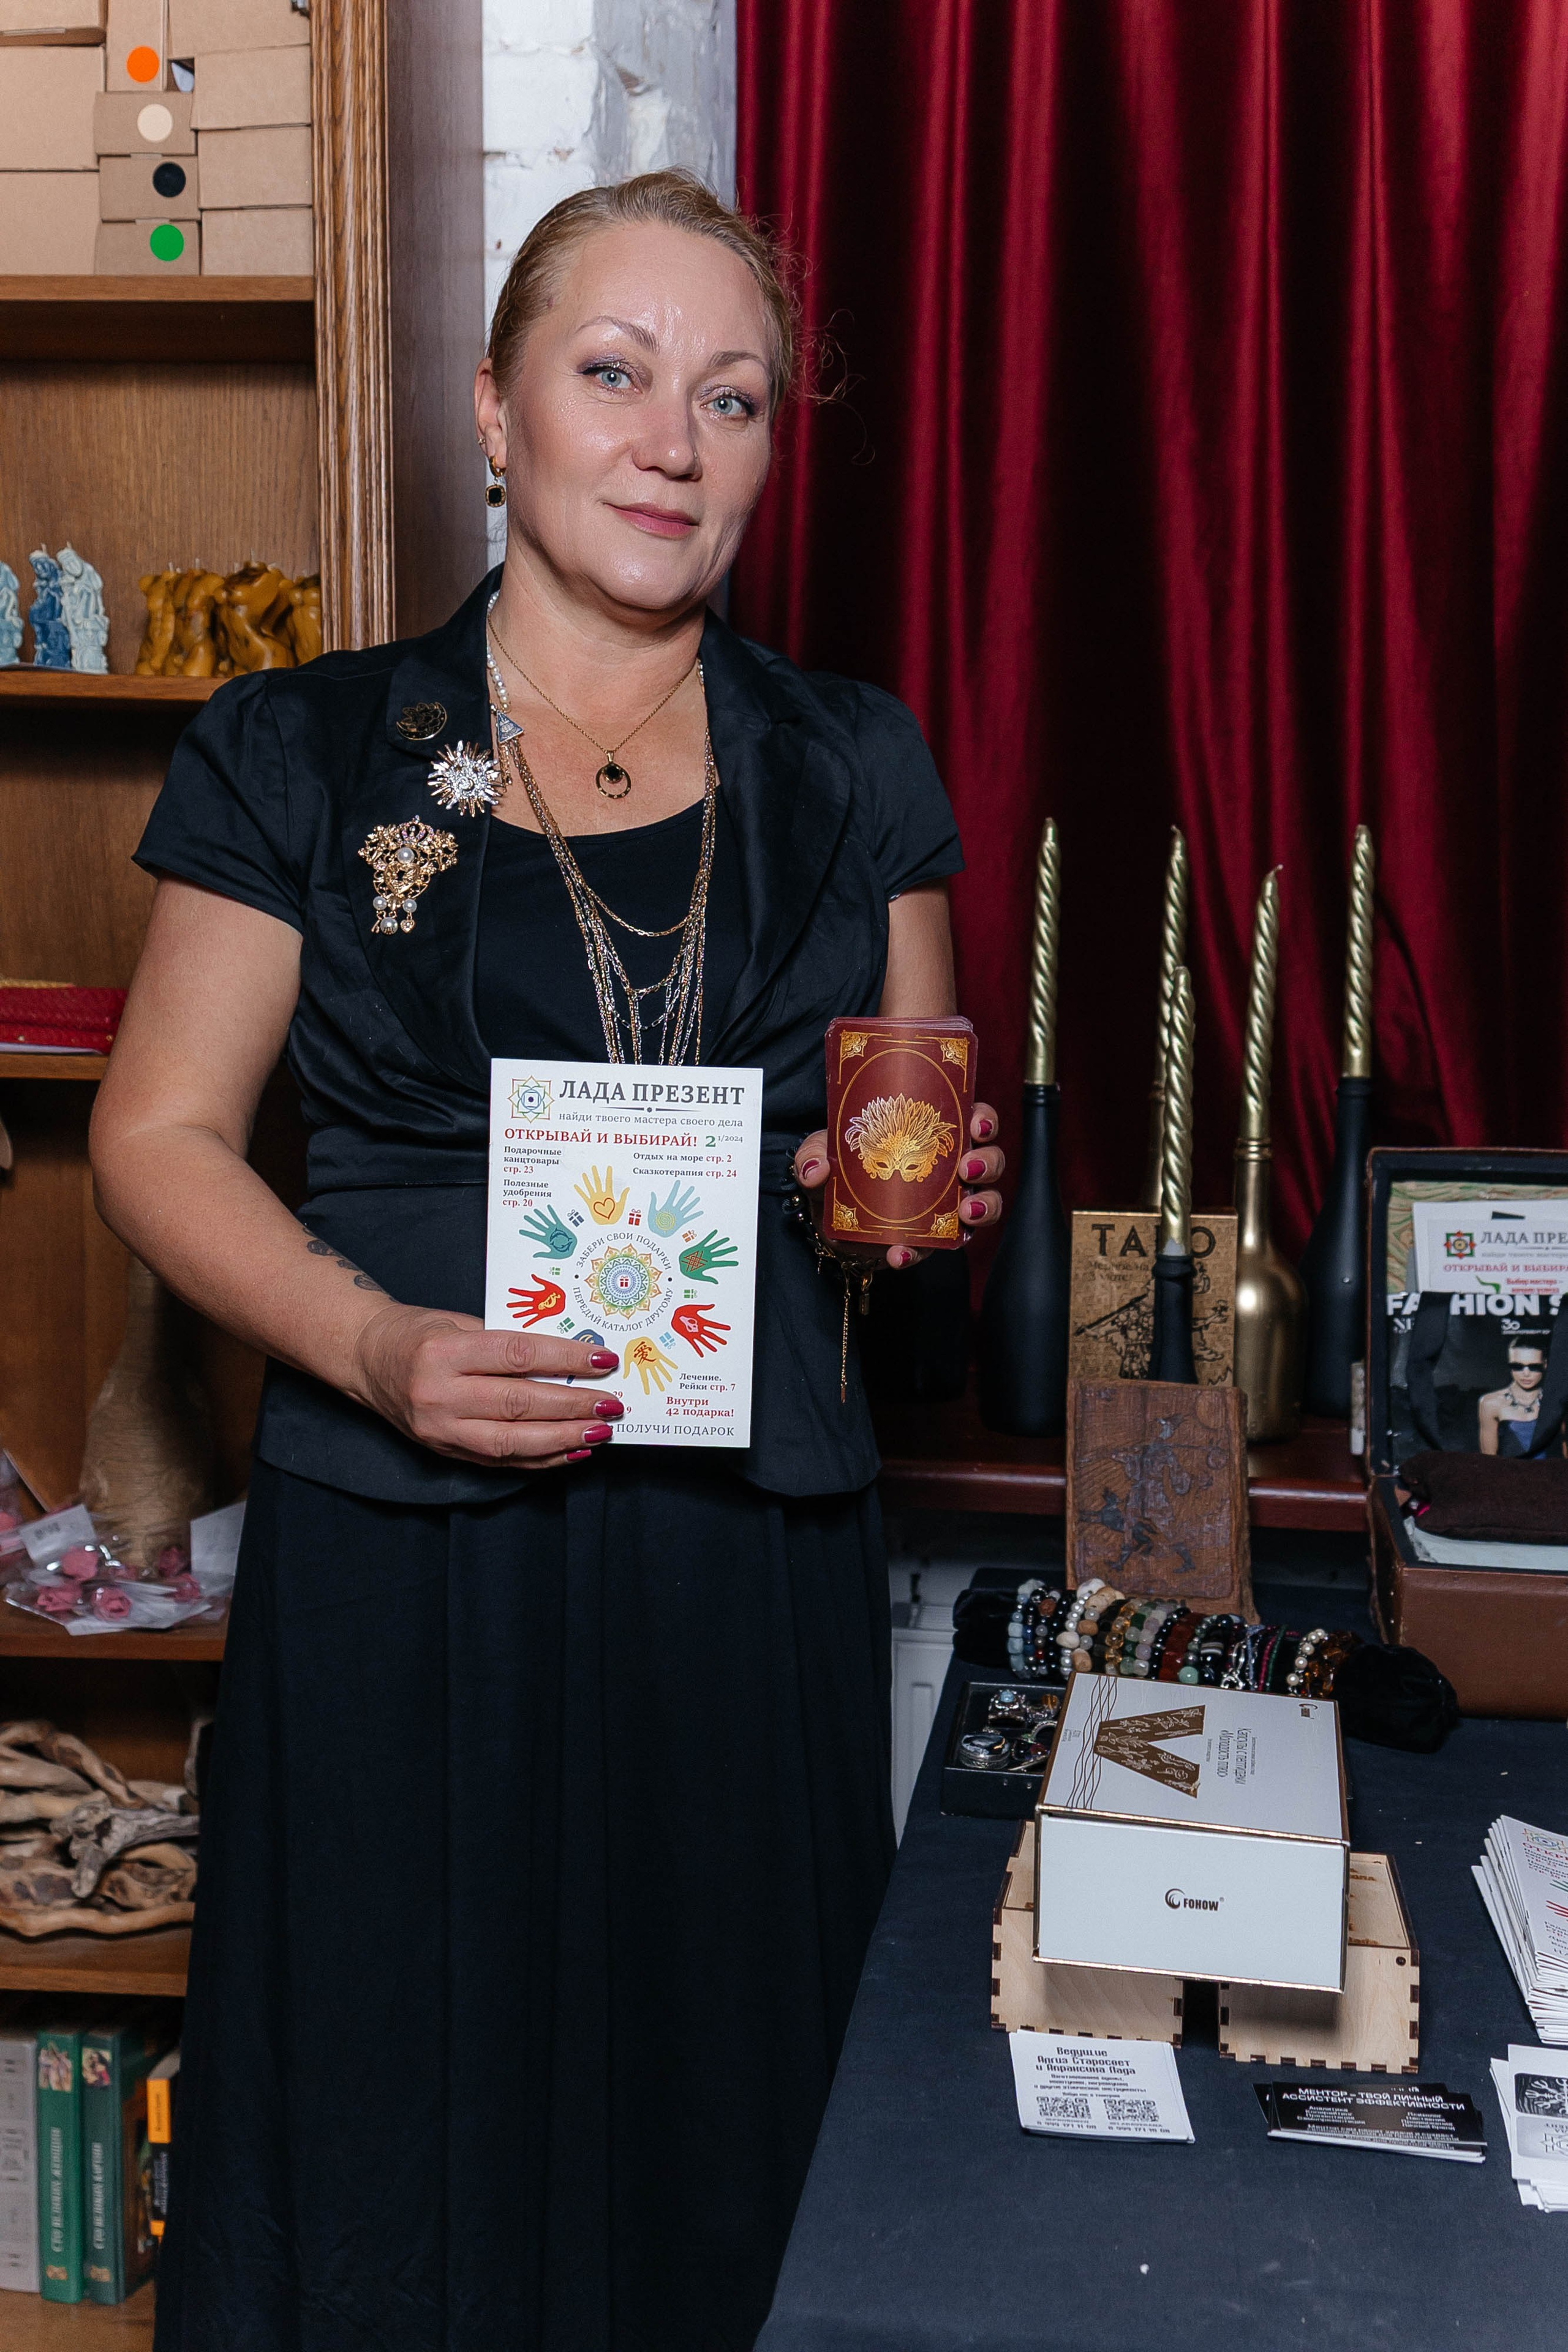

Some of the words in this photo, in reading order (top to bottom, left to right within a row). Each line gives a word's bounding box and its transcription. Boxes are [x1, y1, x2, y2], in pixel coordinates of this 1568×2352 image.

[559, 1080, 625, 1104] ЛАДА
[632, 1084, 744, 1105] ПРЕЗЕНТ
[559, 1112, 592, 1122] найди
[596, 1114, 630, 1123] твоего
[634, 1115, 677, 1126] мастера
[680, 1117, 715, 1126] своего
[718, 1119, 743, 1128] дела
[505, 1128, 591, 1143] ОТКРЫВАЙ
[597, 1133, 608, 1144] И
[614, 1133, 697, 1147] ВЫБИРАЙ!
[706, 1136, 716, 1147] 2
[503, 1146, 562, 1156] Подарочные
[503, 1156, 559, 1166] канцтовары
[633, 1152, 663, 1161] Отдых
[680, 1155, 703, 1163] море
[706, 1156, 724, 1164] стр.
[503, 1166, 521, 1175] стр.
[633, 1167, 703, 1177] Сказкотерапия
[706, 1170, 724, 1179] стр.
[503, 1179, 549, 1188] Полезные
[503, 1188, 552, 1197] удобрения
[502, 1199, 520, 1208] стр.
[1481, 1232, 1529, 1246] ЛАДА
[1534, 1232, 1568, 1244] ПРЕ
[576, 1237, 605, 1268] ЗАБЕРИ
[606, 1232, 633, 1242] СВОИ
[636, 1235, 671, 1270] ПОДАРКИ
[1444, 1263, 1507, 1272] ОТКРЫВАЙ
[573, 1287, 601, 1325] ПЕРЕДАЙ
[601, 1321, 643, 1332] КАТАЛОГ
[646, 1287, 673, 1327] ДРУГОМУ
[1387, 1293, 1540, 1316] FAHION
[679, 1382, 707, 1390] Рейки
[710, 1384, 728, 1393] стр.
[666, 1396, 709, 1408] Внутри
[683, 1409, 734, 1419] подарка!
[616, 1423, 670, 1434] ПОЛУЧИ
[674, 1425, 734, 1436] ПОДАРОК
[1183, 1898, 1219, 1912] FOHOW
[1072, 2056, 1131, 2067] Старосвет
[1047, 2064, 1106, 2073] Апраксина
[1109, 2066, 1136, 2076] Лада
[1298, 2087, 1348, 2098] МЕНТОР
[1358, 2090, 1390, 2100] ТВОЙ
[1393, 2093, 1444, 2103] ЛИЧНЫЙ
[1282, 2092, 1353, 2104] АССИСТЕНТ
[1355, 2097, 1466, 2111] ЭФФЕКТИВНОСТИ
